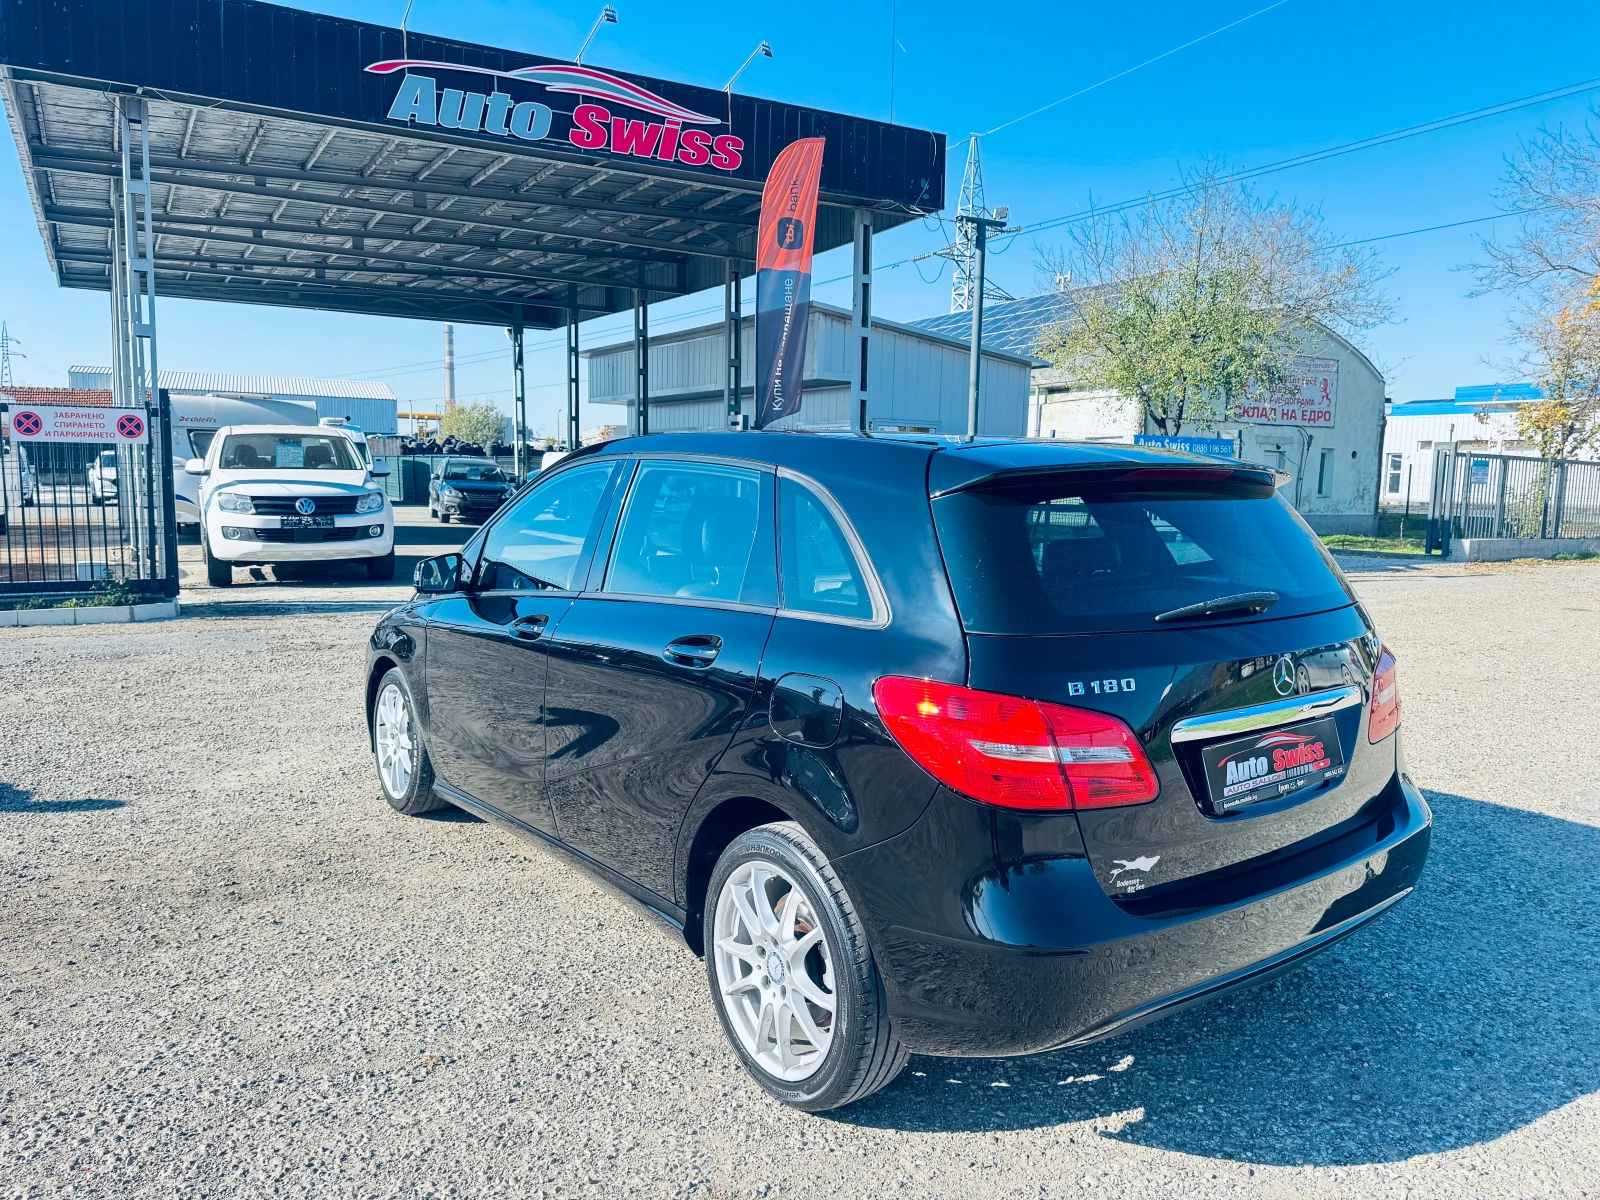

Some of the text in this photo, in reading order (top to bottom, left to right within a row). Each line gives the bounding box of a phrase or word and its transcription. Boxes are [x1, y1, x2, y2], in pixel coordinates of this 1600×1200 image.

[387, 73, 744, 170] Auto Swiss
[785, 179, 799, 244] tbi bank
[772, 379, 784, 411] Купи
[53, 411, 105, 420] ЗАБРАНЕНО
[54, 421, 106, 429] СПИРАНЕТО
[1281, 408, 1297, 421] НА
[1301, 409, 1332, 424] ЕДРО
[53, 430, 116, 439] ПАРКИРАНЕТО
[1164, 438, 1190, 452] Swiss
[1192, 443, 1208, 453] 0888
[1209, 444, 1220, 453] 196
[1220, 445, 1231, 453] 561
[1068, 677, 1136, 696] B 180
[1226, 756, 1269, 786] Auto
[1272, 741, 1325, 772] Swiss
[1227, 773, 1285, 795] AUTO SALLON
